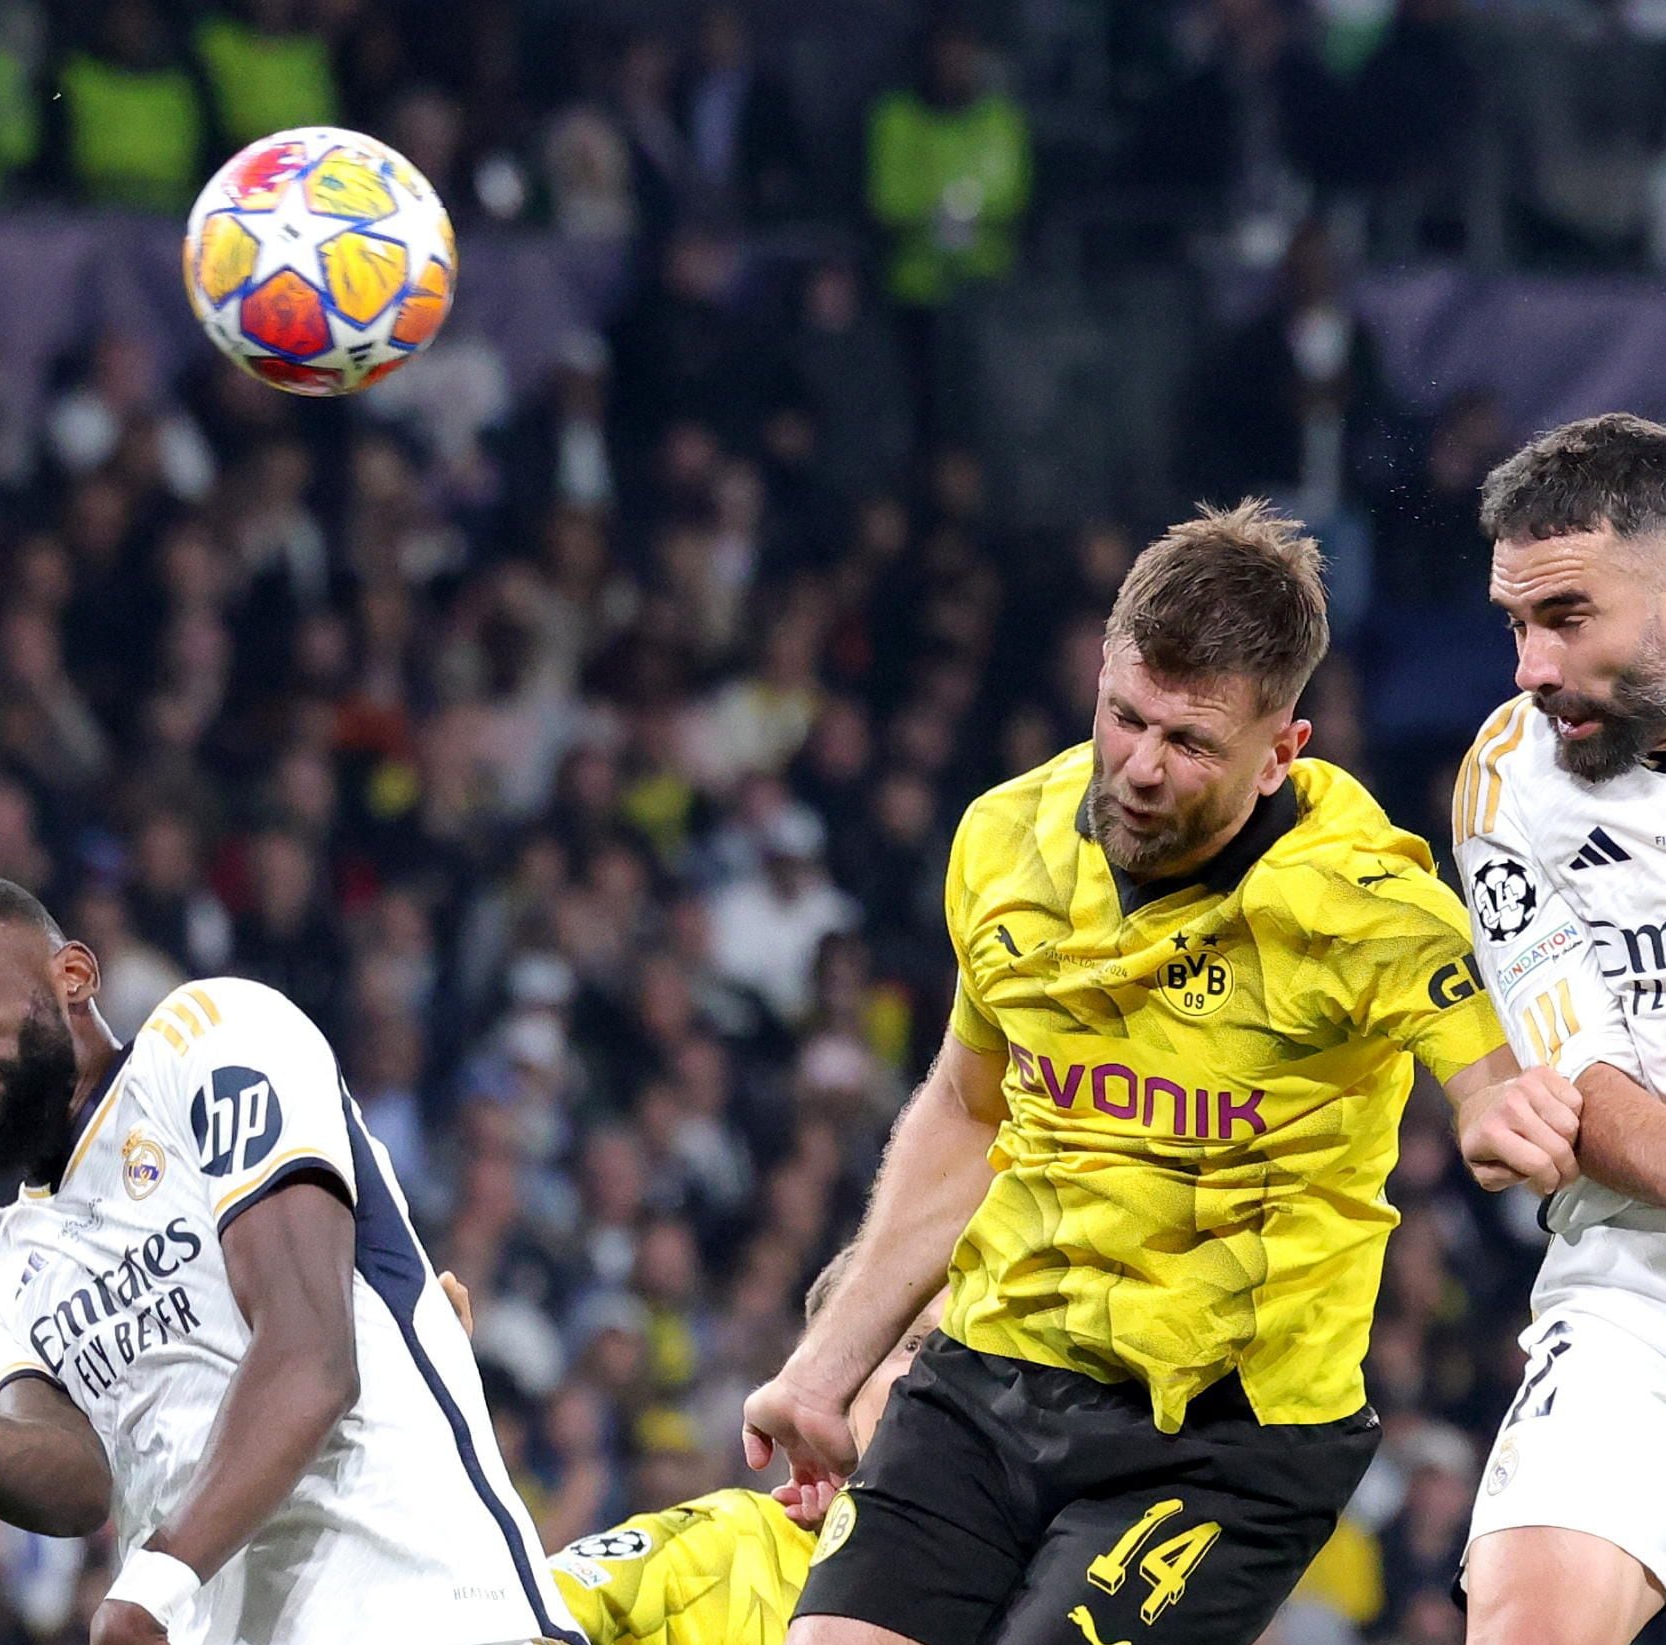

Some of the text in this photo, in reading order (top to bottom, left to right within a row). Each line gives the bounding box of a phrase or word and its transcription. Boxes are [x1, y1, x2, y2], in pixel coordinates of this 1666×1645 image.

[1480, 880, 1521, 926] 14
[1167, 953, 1226, 996] BVB
[1183, 991, 1205, 1009] 09
[1009, 1041, 1268, 1140] EVONIK
[199, 1072, 270, 1177] hp
[74, 1334, 118, 1400] FLY
[1086, 1498, 1223, 1626] 14
